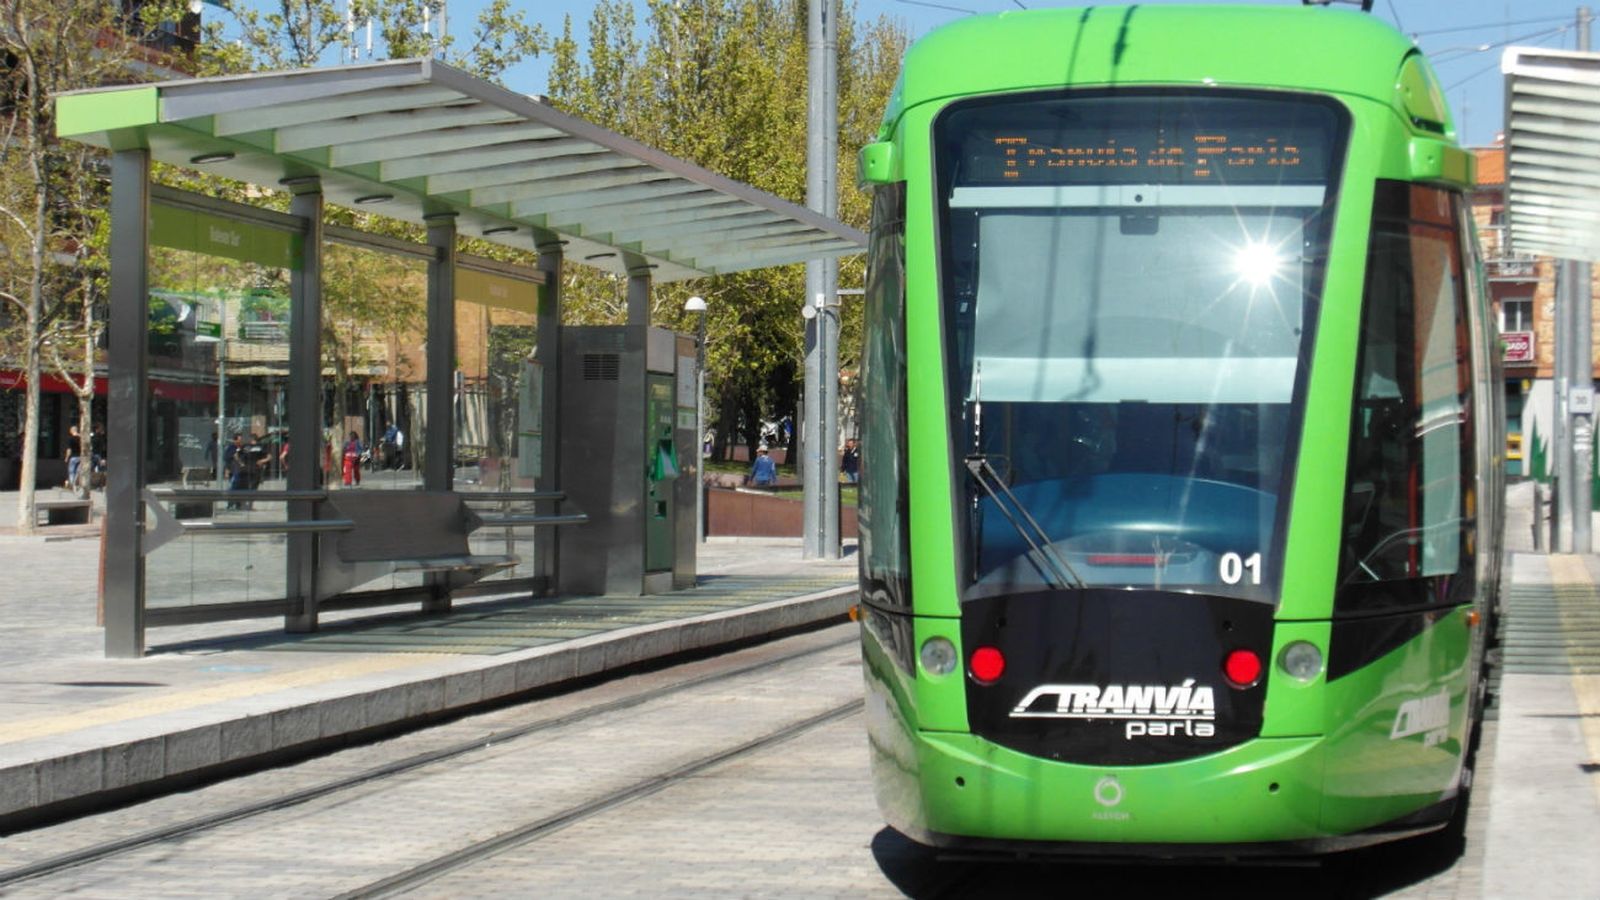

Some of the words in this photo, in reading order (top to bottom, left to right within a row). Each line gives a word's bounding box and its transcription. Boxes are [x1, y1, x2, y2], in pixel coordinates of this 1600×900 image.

[1220, 551, 1261, 585] 01
[1009, 678, 1216, 719] TRANVÍA
[1125, 719, 1216, 740] parla
